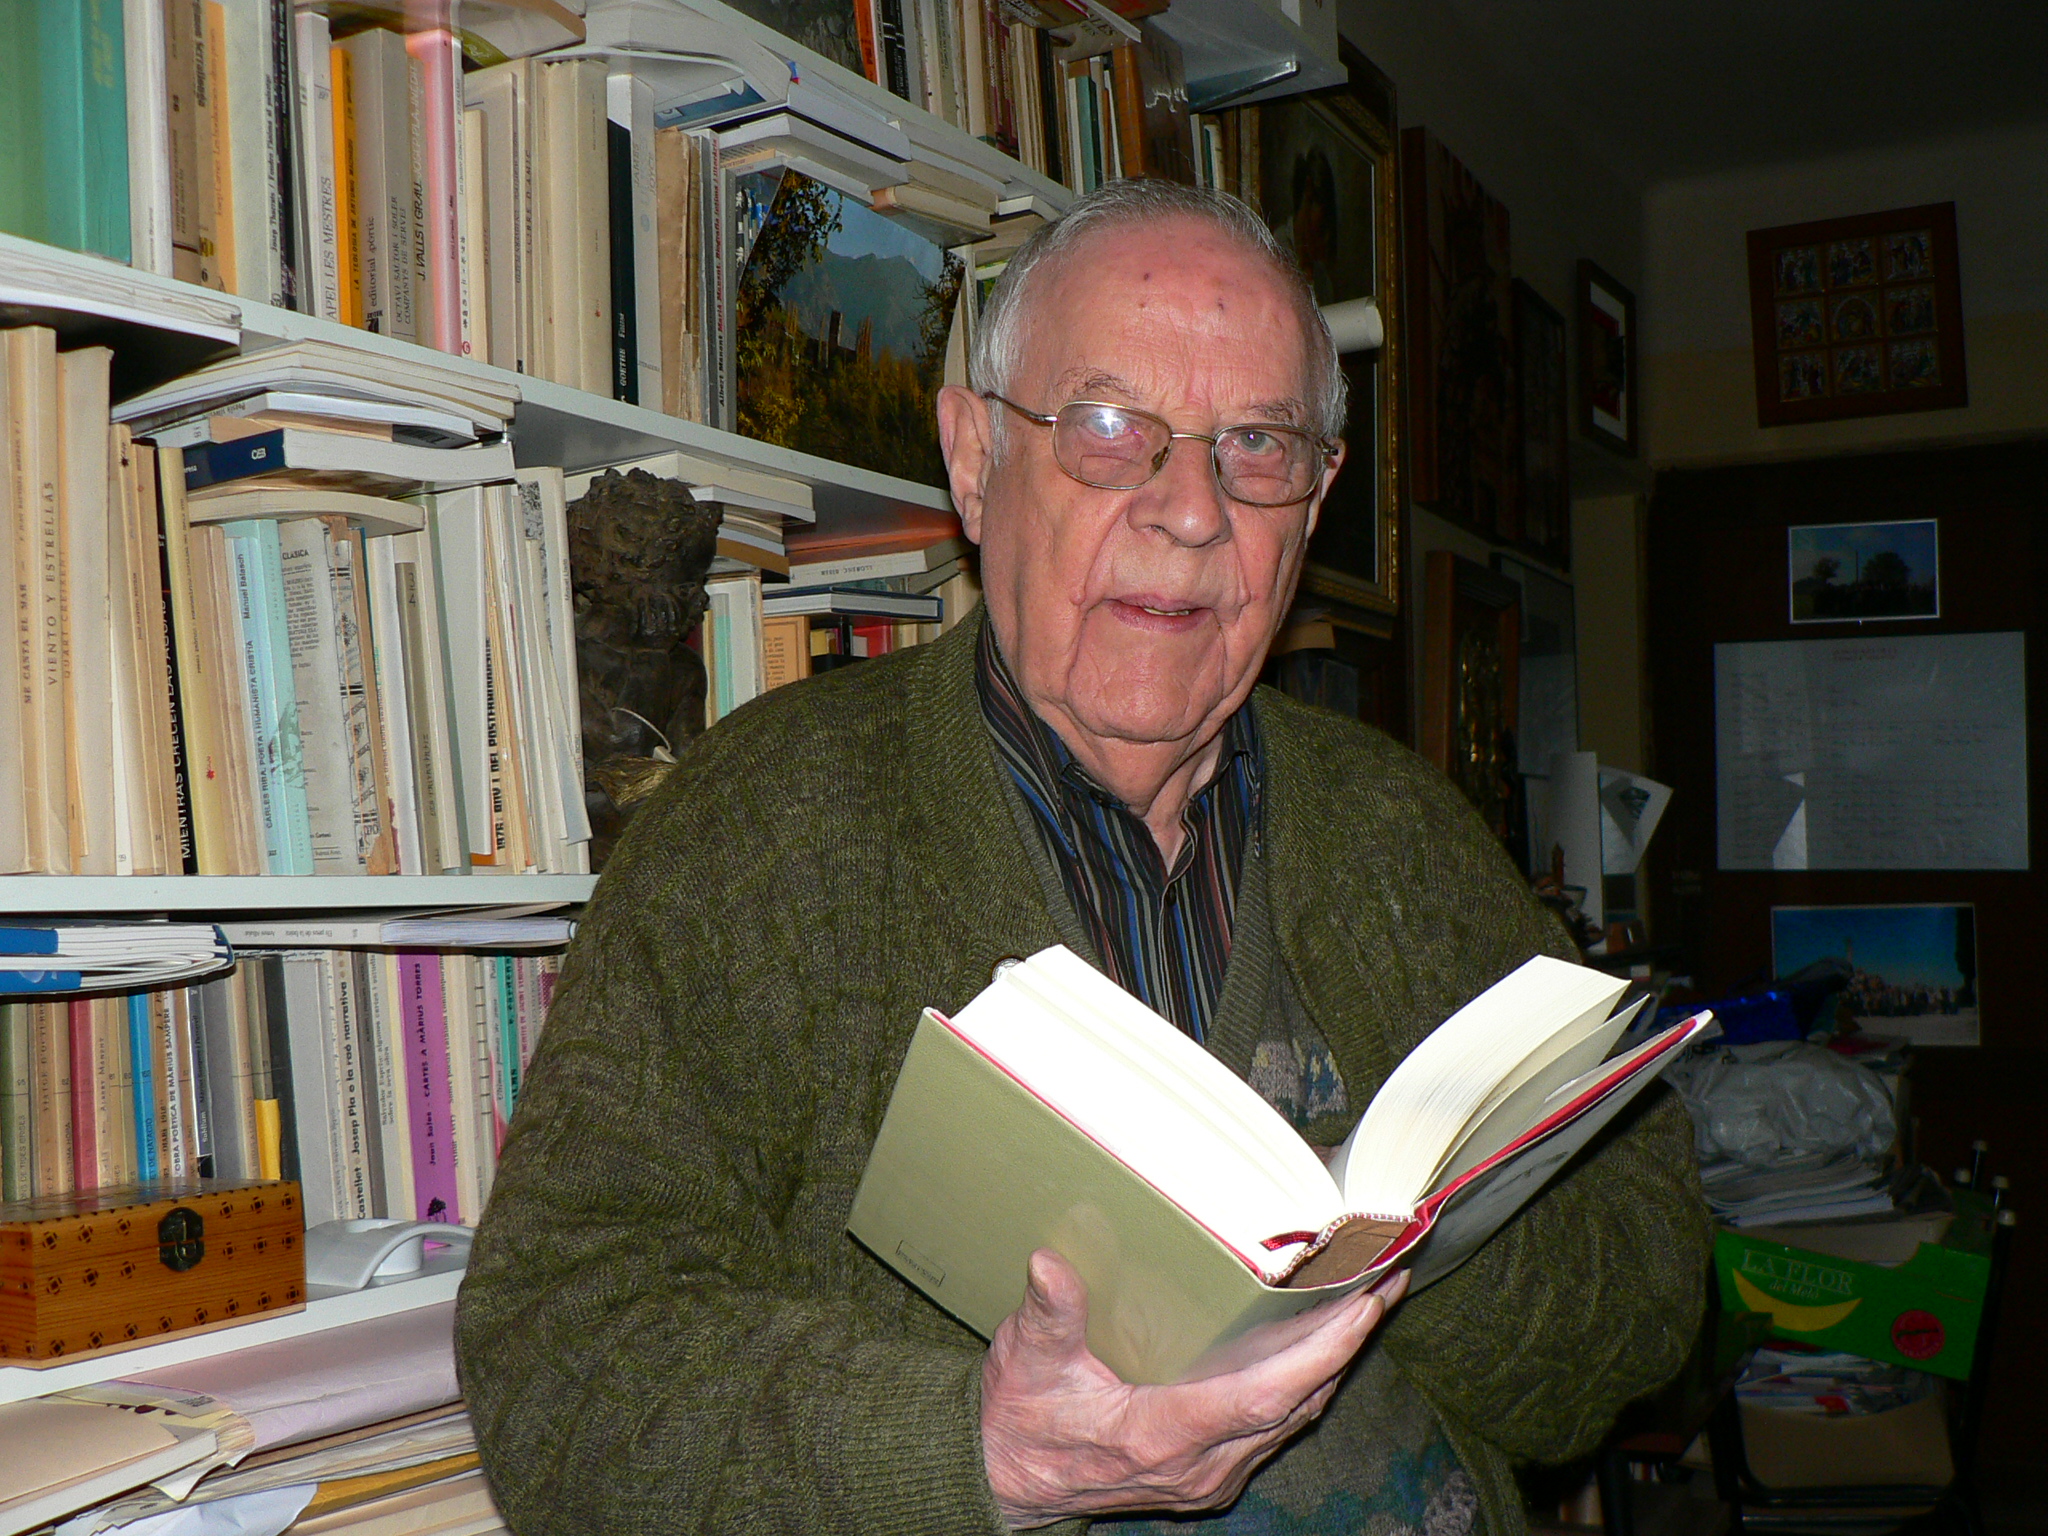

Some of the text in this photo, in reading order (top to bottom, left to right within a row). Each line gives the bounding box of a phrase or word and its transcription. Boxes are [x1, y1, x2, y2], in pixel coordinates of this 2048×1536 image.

[321, 176, 334, 245] MESTRES
[391, 196, 399, 230] SOLER
[351, 232, 359, 272] TEOLOGIA
[400, 208, 411, 324] COMPANYS DE SERVEI
[415, 230, 425, 267] VALLS
[367, 258, 377, 307] editorial
[393, 285, 402, 323] OCTAVI
[617, 312, 628, 386] GOETHE Faust
[44, 480, 58, 686] VIENTO Y ESTRELLAS
[237, 554, 251, 620] Manuel Balasch
[19, 583, 32, 704] ME CANTA EL MAR
[62, 630, 71, 679] QUART
[167, 664, 175, 696] LAS
[249, 677, 263, 728] HUMANISTA
[170, 702, 182, 768] CRECEN
[255, 736, 266, 766] POETA
[175, 772, 191, 859] MIENTRAS
[261, 792, 273, 829] CARLES
[413, 962, 424, 999] TORRES
[516, 956, 525, 988] VERDAGUE
[164, 1008, 173, 1049] SAMPERE
[340, 982, 352, 1040] narrativa
[417, 1004, 427, 1043] MÀRIUS
[374, 1020, 383, 1052] algunes
[167, 1052, 176, 1088] MÀRIUS
[344, 1044, 354, 1066] raó
[346, 1069, 355, 1082] la
[421, 1061, 431, 1097] CARTES
[169, 1090, 177, 1102] DE
[348, 1097, 358, 1116] Pla
[379, 1089, 388, 1126] Salvador
[387, 1102, 395, 1124] sobre
[170, 1105, 180, 1143] POÈTICA
[350, 1120, 361, 1156] Josep
[425, 1111, 434, 1137] Sales
[148, 1155, 155, 1167] DE
[427, 1142, 436, 1166] Joan
[353, 1166, 366, 1220] Castellet
[1741, 1248, 1855, 1295] LA FLOR
